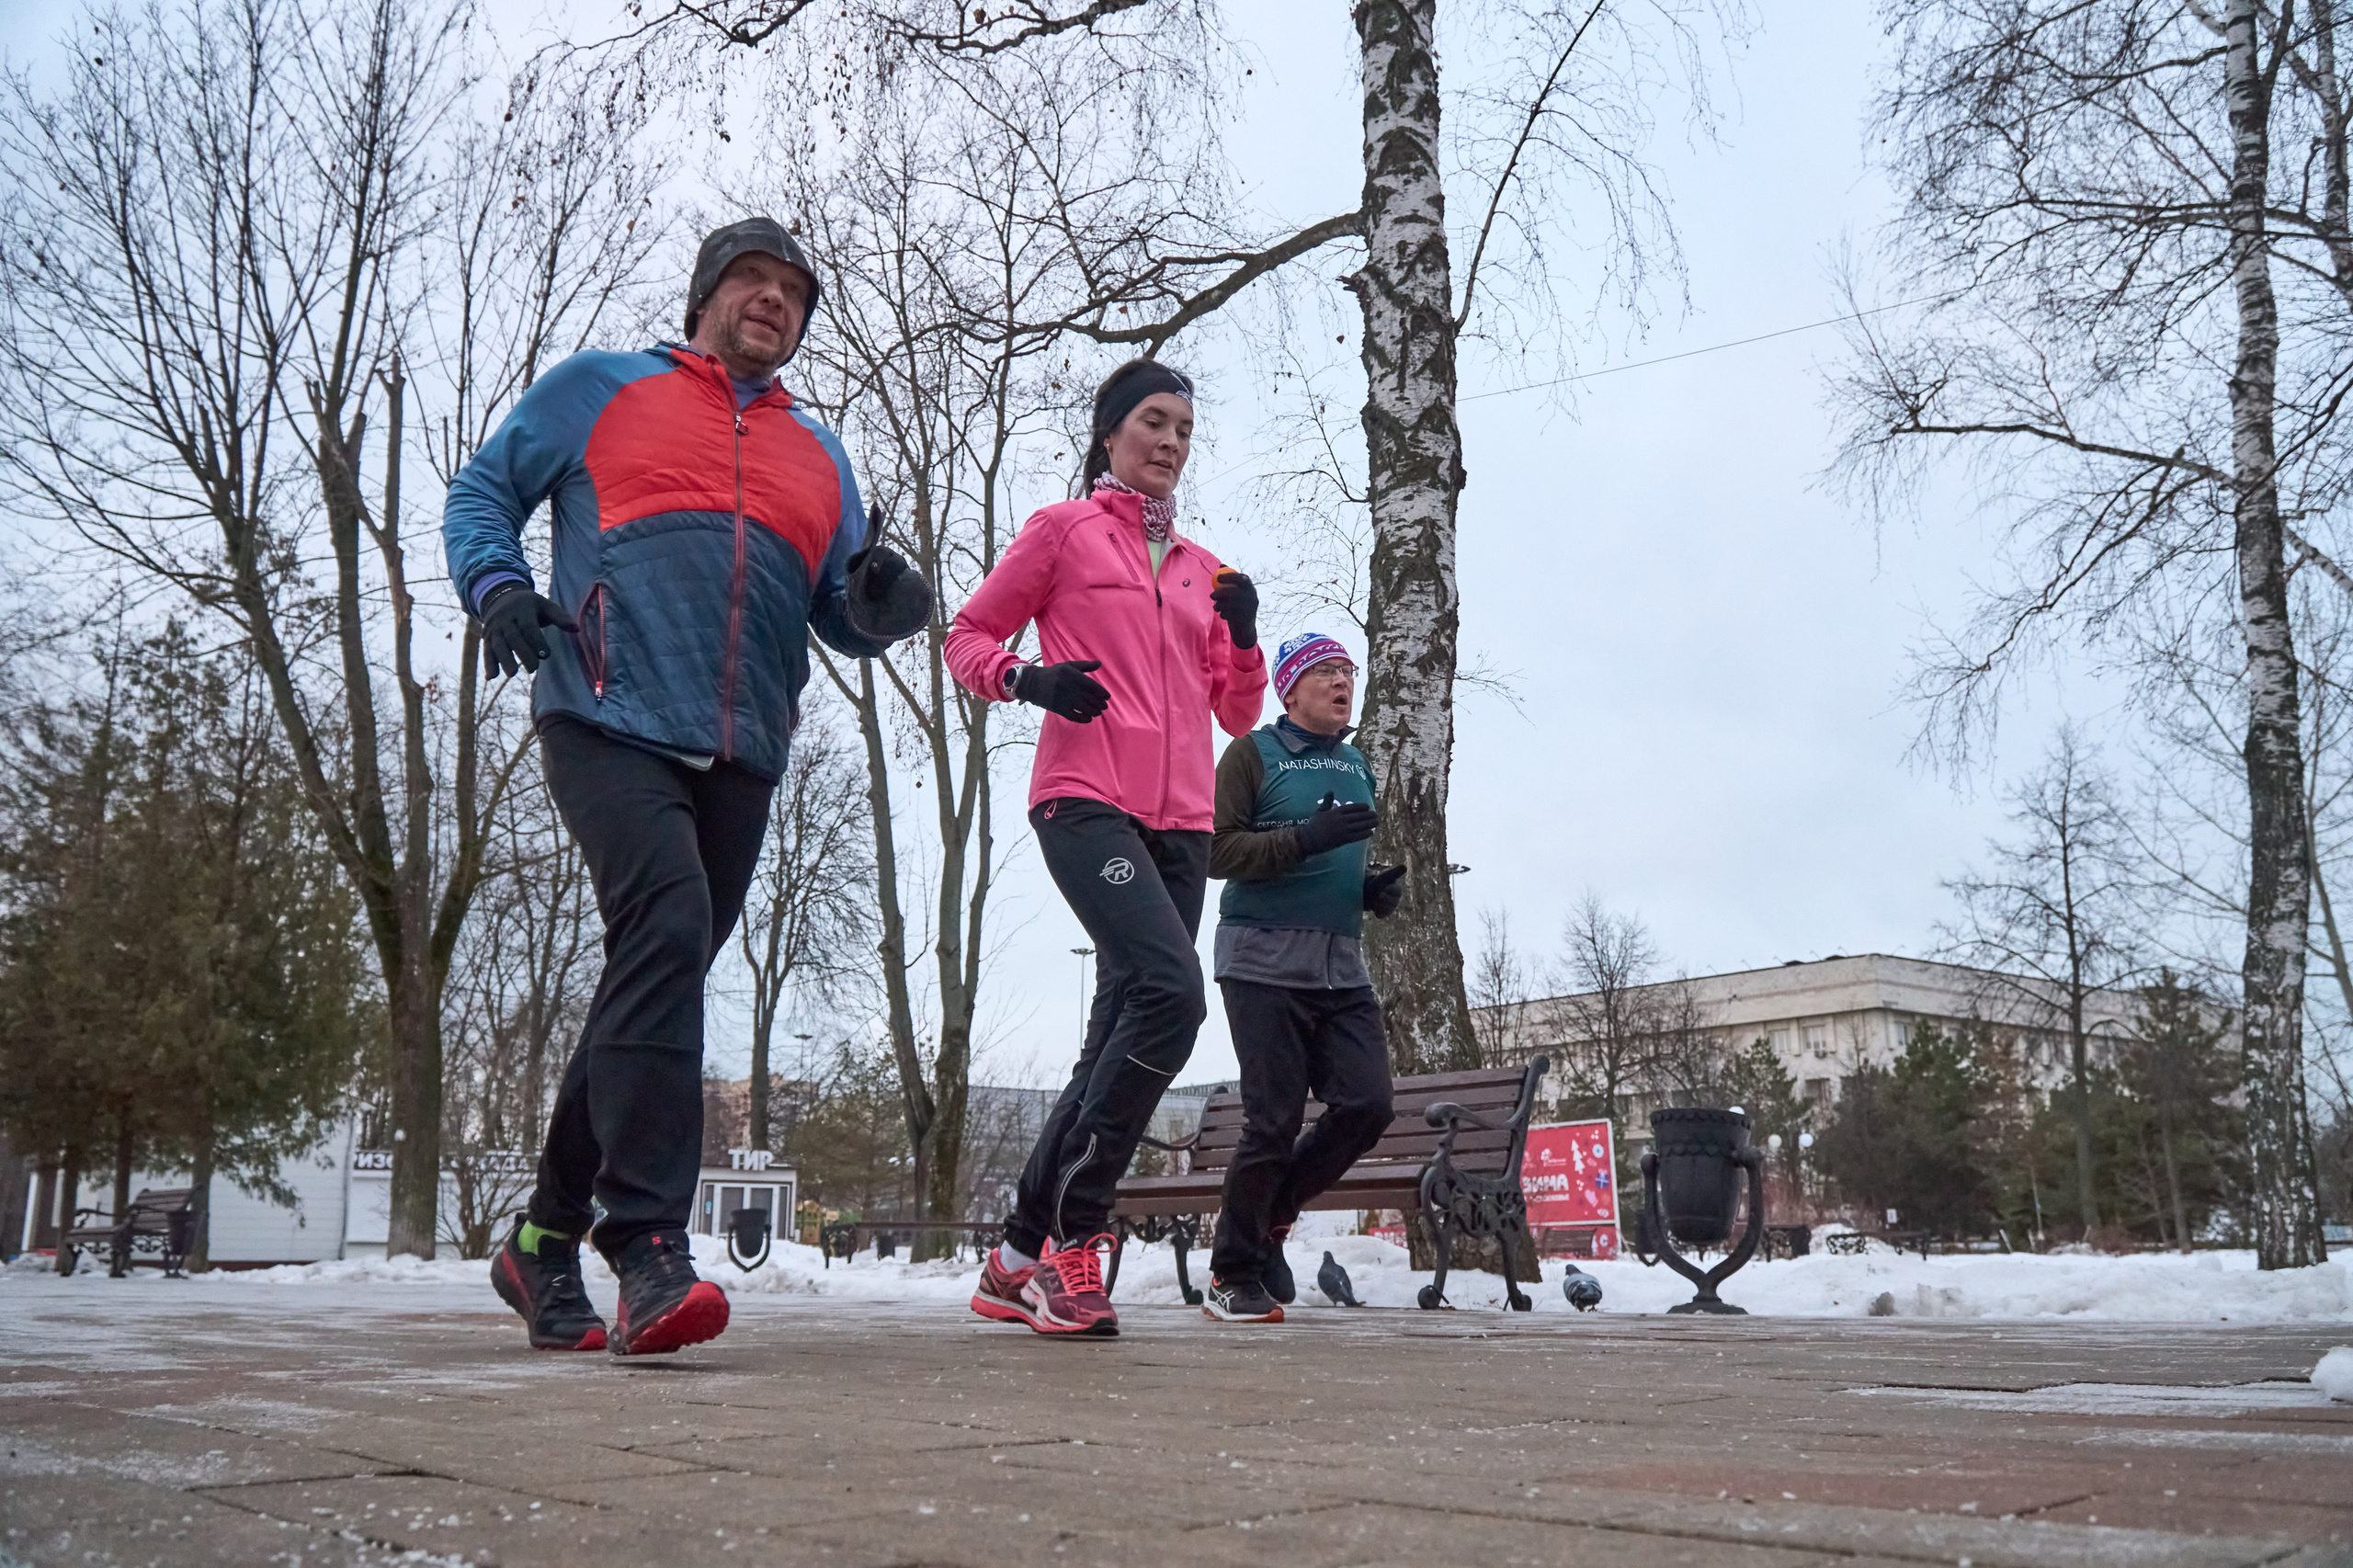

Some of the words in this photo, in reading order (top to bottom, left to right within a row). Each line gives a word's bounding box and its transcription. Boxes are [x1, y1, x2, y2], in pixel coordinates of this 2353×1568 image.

[1279, 758, 1355, 774] NATASHINSKY
[1257, 819, 1293, 828] СЕГОДНЯ
[728, 1149, 774, 1171] ТИР
